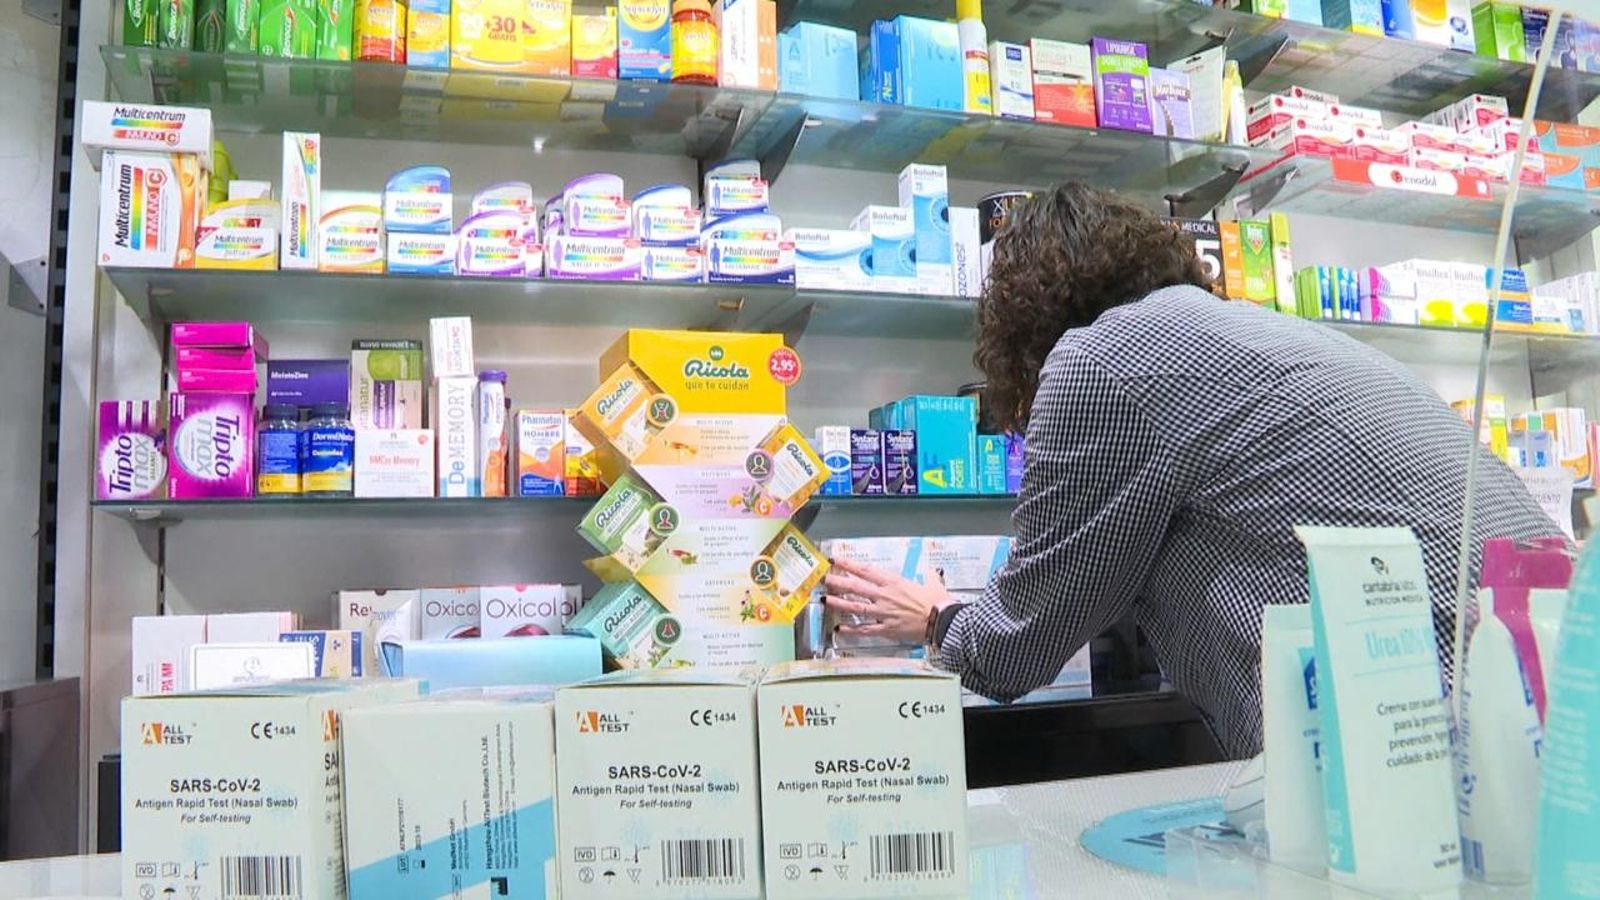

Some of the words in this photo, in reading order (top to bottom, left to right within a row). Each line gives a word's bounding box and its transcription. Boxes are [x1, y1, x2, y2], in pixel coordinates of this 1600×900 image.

[113, 107, 186, 122] Multicentrum
[115, 164, 132, 248] Multicentrum
[1181, 222, 1217, 234] MEDICAL
[214, 234, 264, 245] Multicentrum
[326, 237, 378, 249] Multicentrum
[565, 243, 626, 255] Multicentrum
[723, 246, 781, 257] Multicentrum
[1195, 239, 1221, 280] 5
[684, 359, 750, 379] Ricola
[685, 381, 704, 391] que
[705, 380, 715, 390] te
[718, 379, 749, 390] cuidan
[597, 379, 633, 415] Ricola
[521, 415, 562, 424] Pharmaton
[197, 418, 212, 476] max
[212, 415, 240, 478] Tripto
[109, 435, 134, 493] Tripto
[134, 436, 149, 490] max
[786, 442, 814, 476] Ricola
[597, 489, 632, 528] Ricola
[786, 536, 815, 568] Ricola
[486, 597, 557, 618] Oxicol
[604, 595, 642, 633] Ricola
[805, 707, 827, 716] ALL
[922, 704, 946, 714] 1434
[599, 714, 621, 723] ALL
[714, 712, 737, 722] 1434
[806, 716, 837, 726] TEST
[163, 725, 184, 735] ALL
[274, 726, 296, 735] 1434
[600, 723, 630, 733] TEST
[163, 735, 193, 745] TEST
[608, 764, 702, 780] SARS-CoV-2
[814, 758, 911, 775] SARS-CoV-2
[170, 779, 261, 793] SARS-CoV-2
[572, 785, 612, 797] Antigen
[615, 784, 645, 795] Rapid
[648, 784, 669, 793] Test
[672, 783, 704, 794] (Nasal
[707, 782, 740, 793] Swab)
[777, 780, 819, 792] Antigen
[821, 779, 853, 790] Rapid
[856, 779, 877, 788] Test
[880, 777, 914, 788] (Nasal
[916, 775, 950, 786] Swab)
[135, 799, 173, 810] Antigen
[176, 799, 205, 810] Rapid
[208, 799, 228, 808] Test
[232, 799, 263, 809] (Nasal
[266, 798, 298, 809] Swab)
[620, 800, 636, 809] For
[638, 799, 692, 809] Self-testing
[827, 795, 844, 804] For
[846, 793, 901, 804] Self-testing
[180, 814, 196, 823] For
[198, 814, 251, 824] Self-testing
